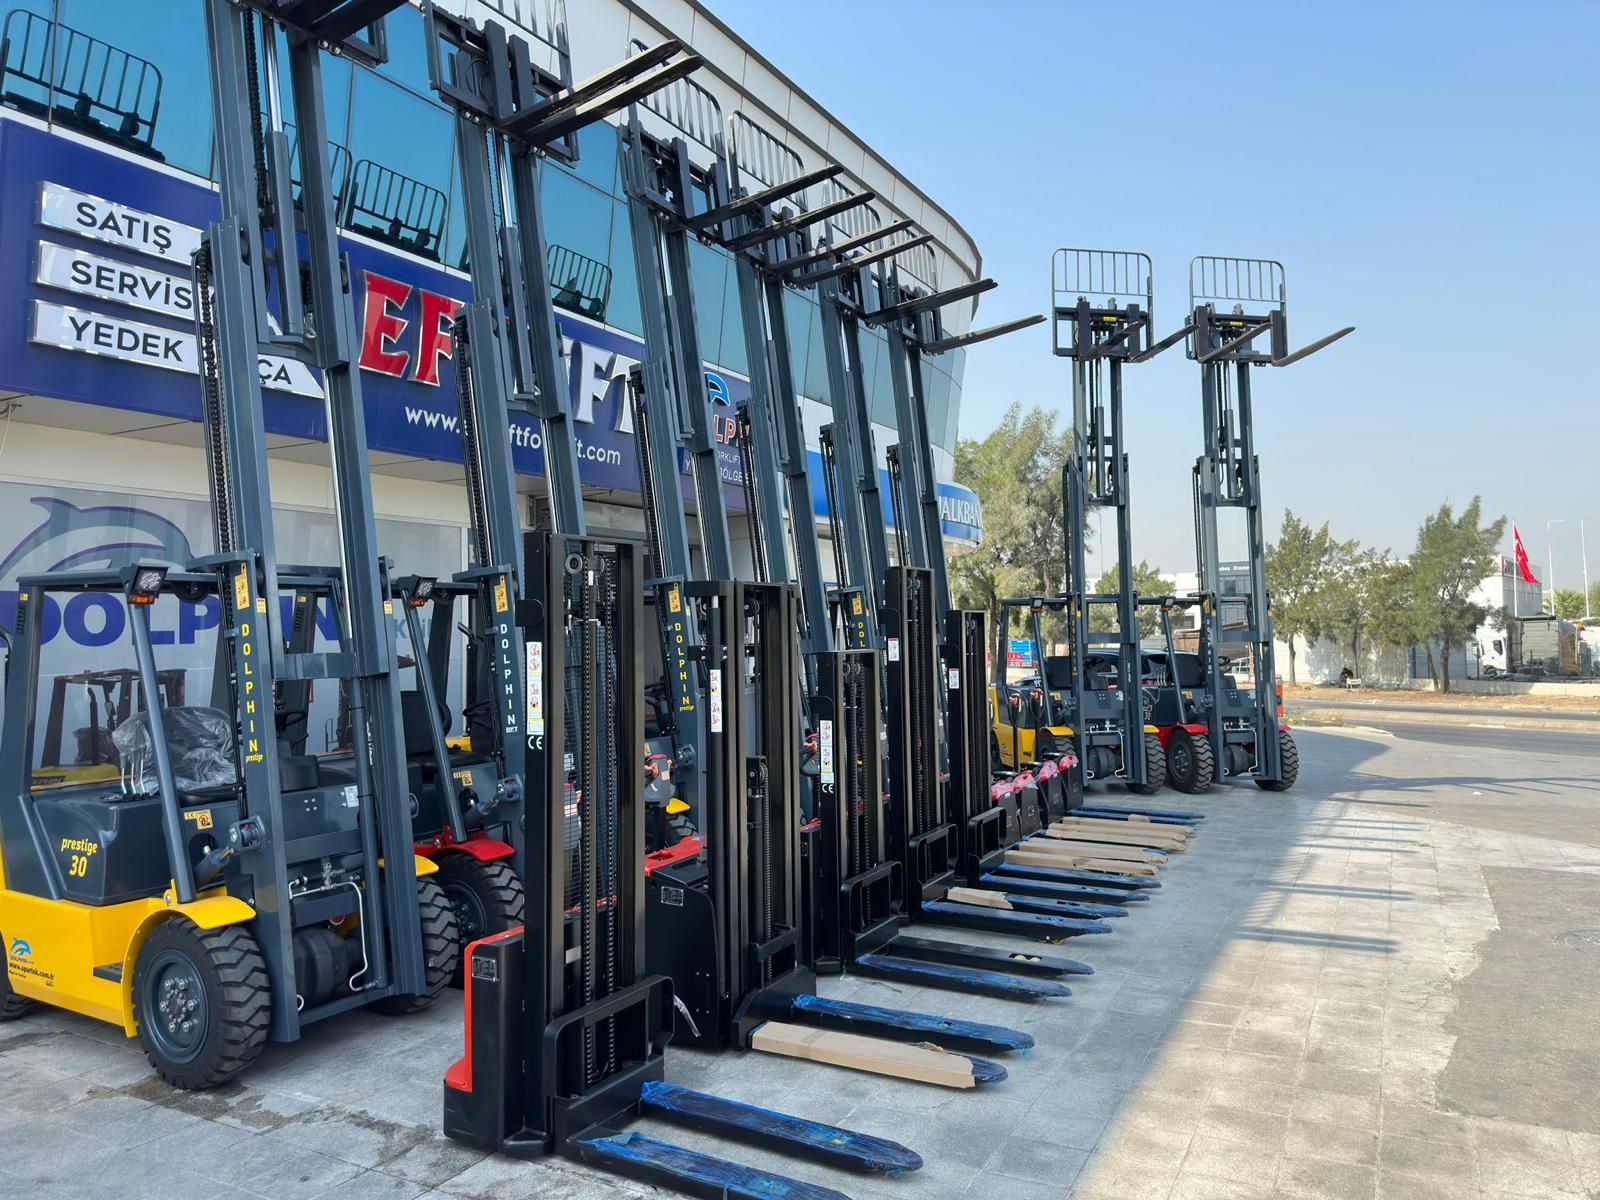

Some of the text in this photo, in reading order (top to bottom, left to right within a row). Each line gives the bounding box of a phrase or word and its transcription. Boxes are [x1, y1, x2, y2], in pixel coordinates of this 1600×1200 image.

[76, 201, 172, 254] SATIŞ
[71, 260, 192, 310] SERVİS
[68, 316, 183, 362] YEDEK
[938, 496, 984, 528] ALKBAN
[500, 624, 516, 725] DOLPHIN
[674, 623, 690, 705] DOLPHIN
[242, 624, 258, 752] DOLPHIN
[245, 754, 263, 763] prestige
[528, 736, 543, 750] CE
[61, 838, 98, 854] prestige
[69, 854, 88, 877] 30
